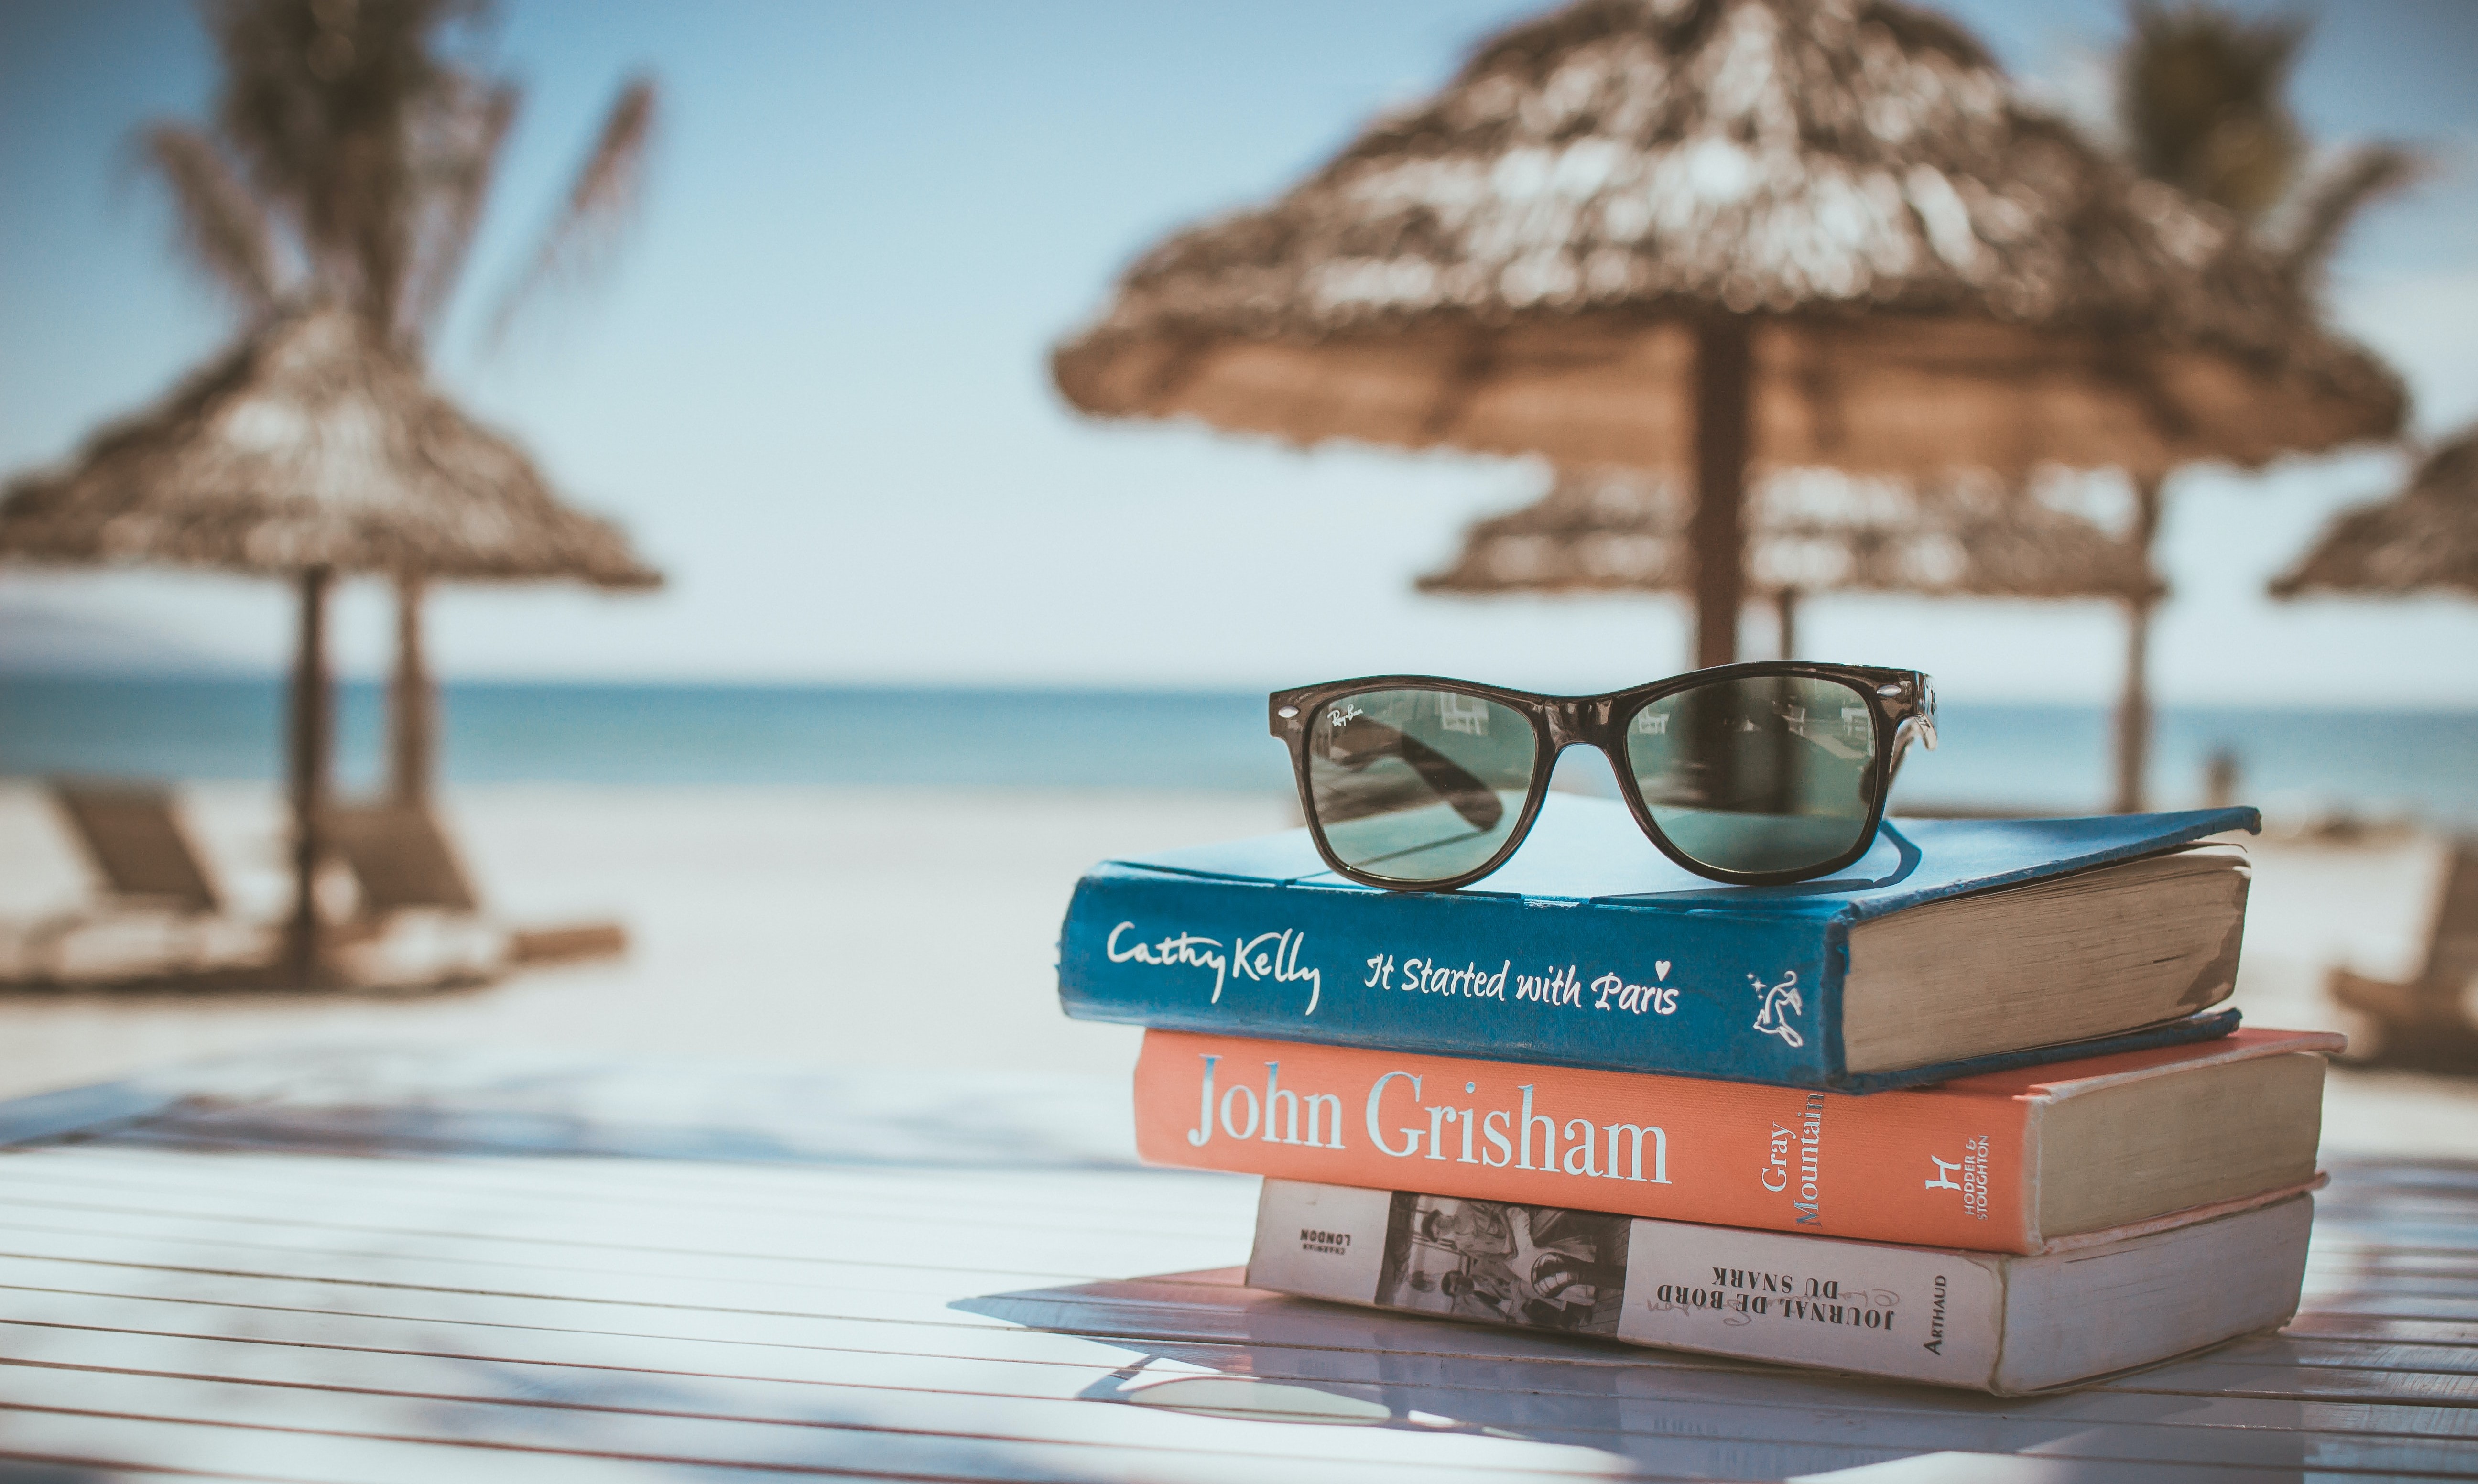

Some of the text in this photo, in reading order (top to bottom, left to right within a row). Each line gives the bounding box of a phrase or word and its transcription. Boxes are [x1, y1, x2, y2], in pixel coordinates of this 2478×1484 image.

[1107, 921, 1320, 1016] Cathy Kelly
[1364, 953, 1679, 1015] It Started with Paris
[1188, 1055, 1672, 1184] John Grisham
[1761, 1121, 1796, 1192] Gray
[1793, 1094, 1825, 1228] Mountain
[1925, 1155, 1961, 1190] H
[1964, 1138, 1977, 1215] HODDER &
[1976, 1135, 1989, 1220] STOUGHTON
[1300, 1229, 1351, 1246] LONDON
[1657, 1284, 1724, 1309] BORD
[1712, 1267, 1838, 1300] DU SNARK
[1735, 1294, 1767, 1315] DE
[1781, 1299, 1895, 1330] JOURNAL
[1923, 1275, 1946, 1356] ARTHAUD
